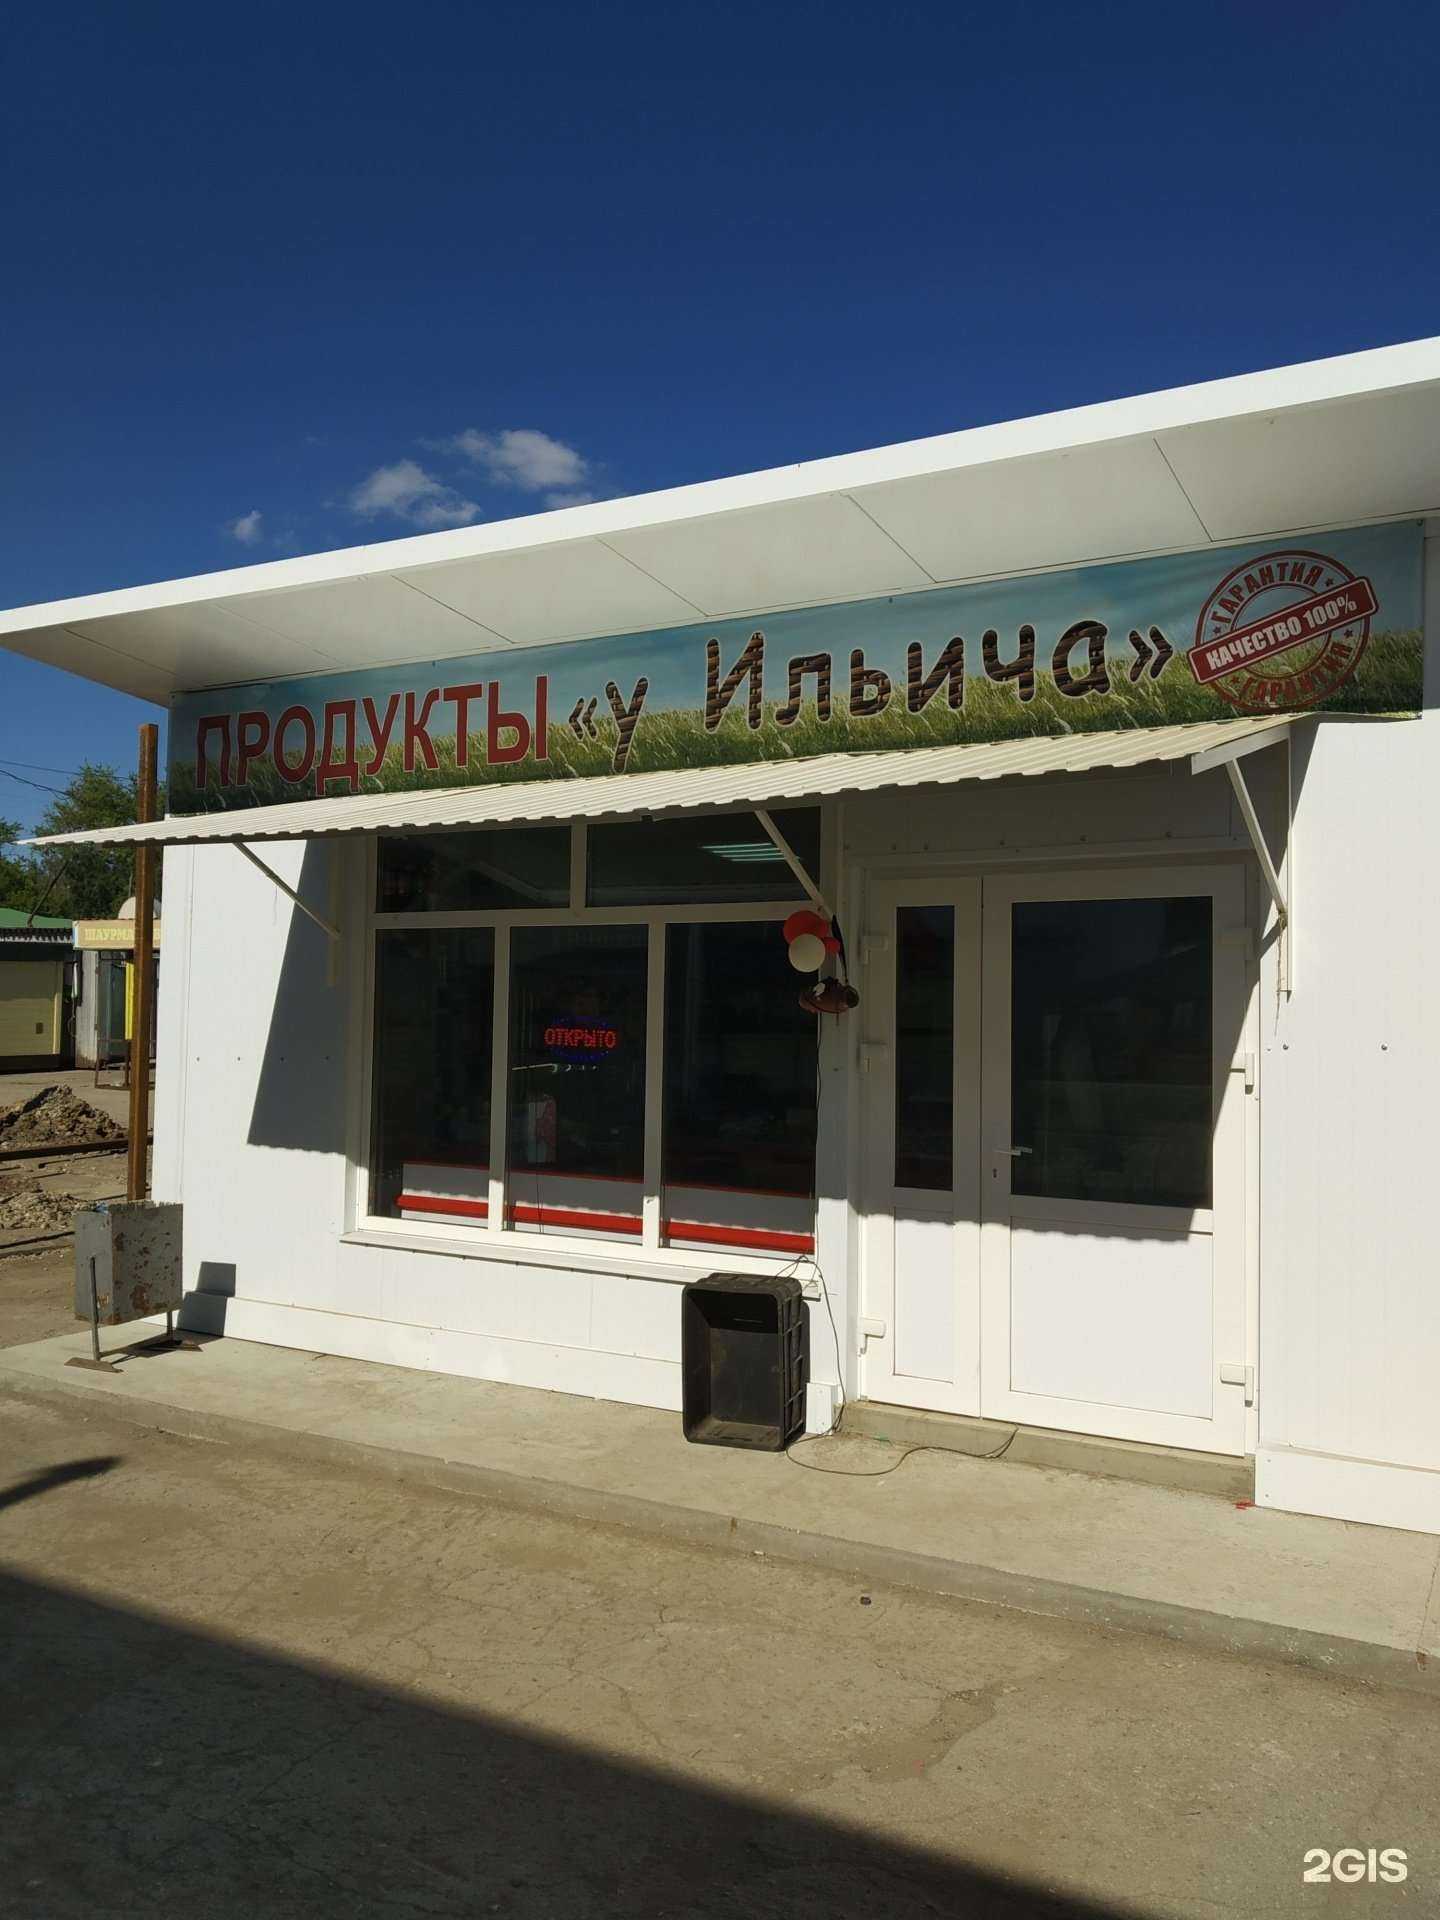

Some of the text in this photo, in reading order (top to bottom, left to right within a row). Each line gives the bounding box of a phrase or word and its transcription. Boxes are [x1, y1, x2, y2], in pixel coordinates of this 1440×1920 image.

[1210, 561, 1325, 625] ГАРАНТИЯ
[1205, 592, 1358, 671] КАЧЕСТВО 100%
[195, 674, 549, 797] ПРОДУКТЫ
[703, 618, 1175, 735] Ильича»
[544, 1027, 617, 1050] ОТКРЫТО
